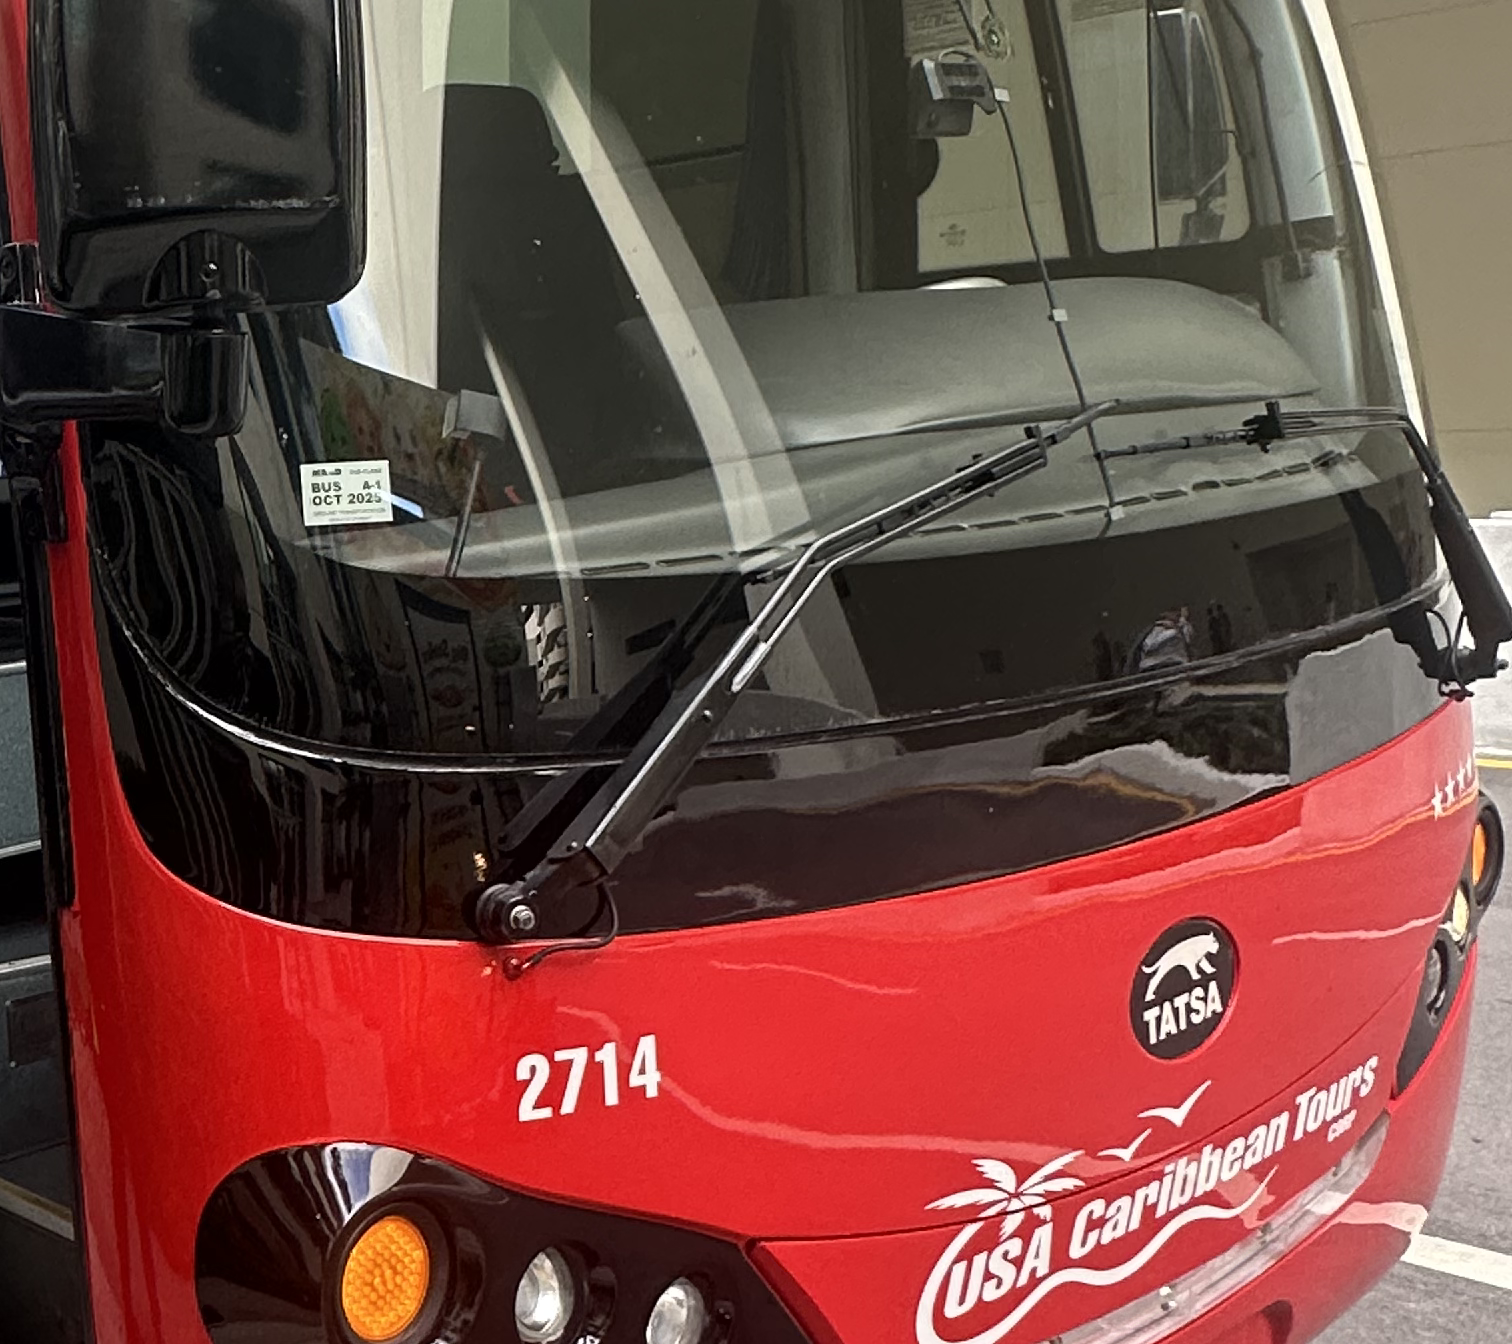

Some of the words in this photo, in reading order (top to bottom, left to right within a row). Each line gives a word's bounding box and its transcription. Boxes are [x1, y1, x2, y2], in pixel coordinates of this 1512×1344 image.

[310, 481, 342, 494] BUS
[362, 479, 382, 490] A-1
[312, 494, 343, 506] OCT
[346, 492, 383, 505] 2025
[1142, 980, 1224, 1046] TATSA
[515, 1033, 662, 1123] 2714
[943, 1220, 1054, 1320] USA
[1068, 1110, 1292, 1260] Caribbean
[1292, 1055, 1380, 1142] Tours
